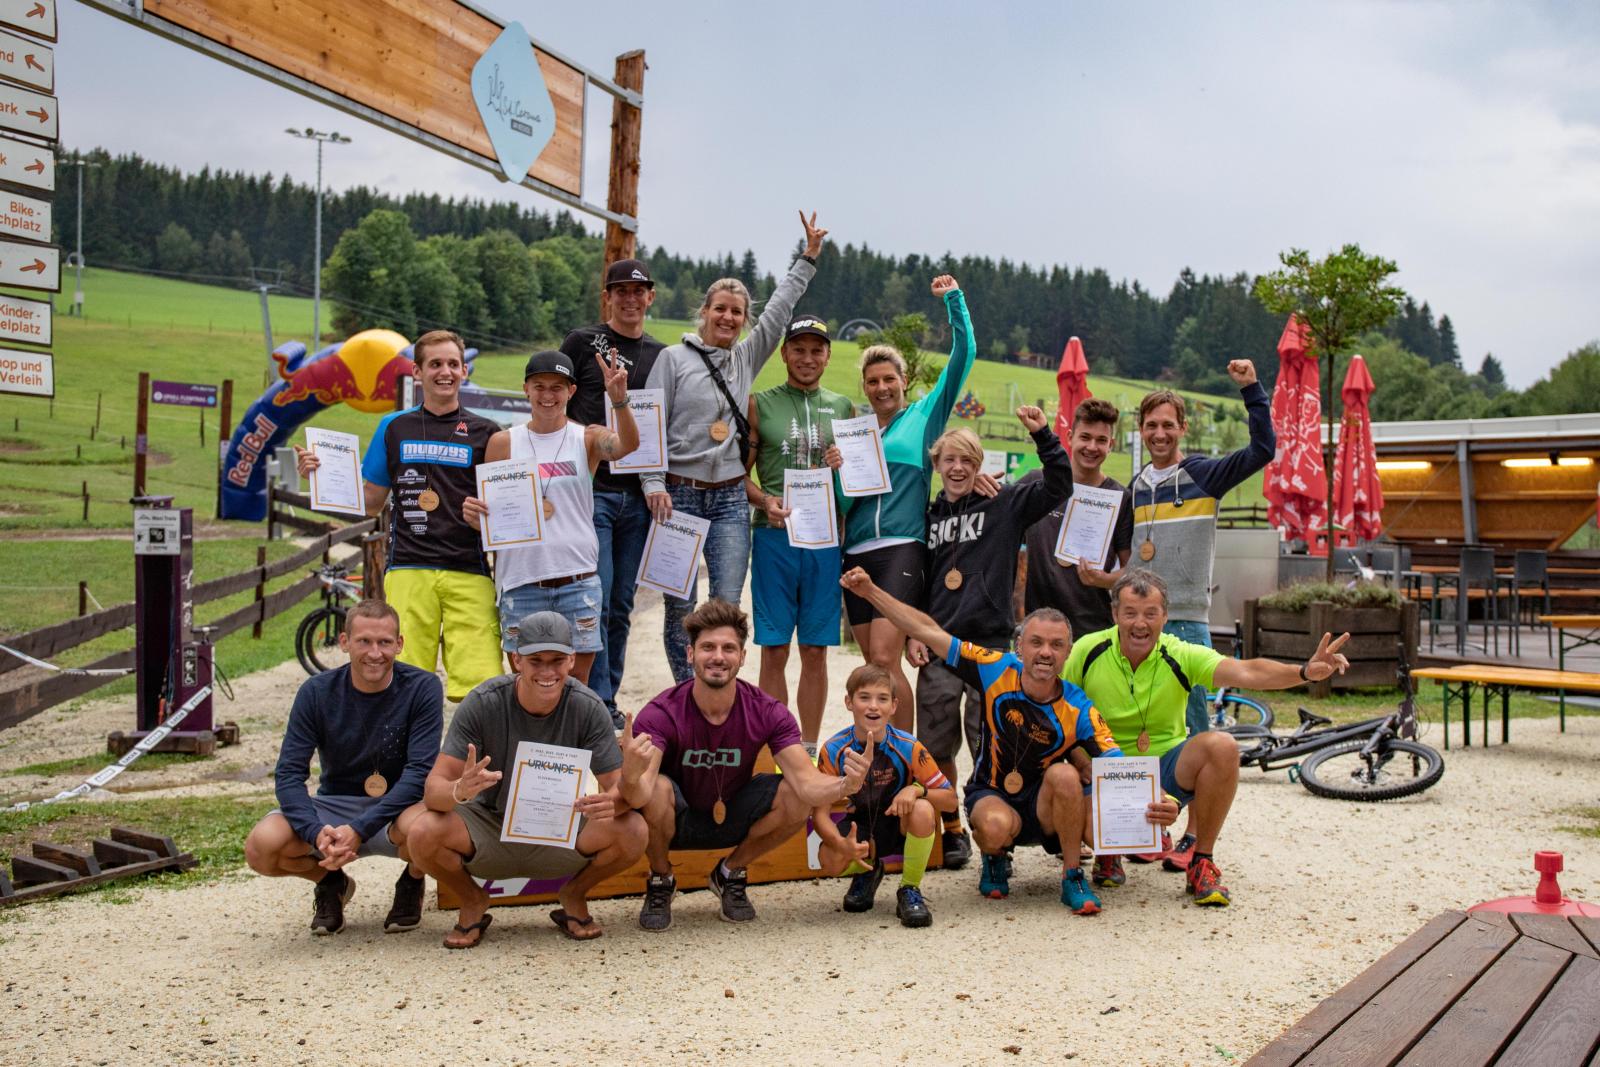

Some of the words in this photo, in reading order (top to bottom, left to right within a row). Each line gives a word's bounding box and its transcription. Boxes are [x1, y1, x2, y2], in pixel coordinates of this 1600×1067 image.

[20, 360, 42, 372] und
[242, 412, 278, 454] Bull
[227, 444, 258, 487] Red
[487, 471, 528, 484] URKUNDE
[790, 481, 823, 490] URKUNDE
[661, 520, 697, 538] URKUNDE
[928, 512, 985, 550] SICK!
[528, 758, 576, 775] URKUNDE
[1103, 771, 1147, 781] URKUNDE
